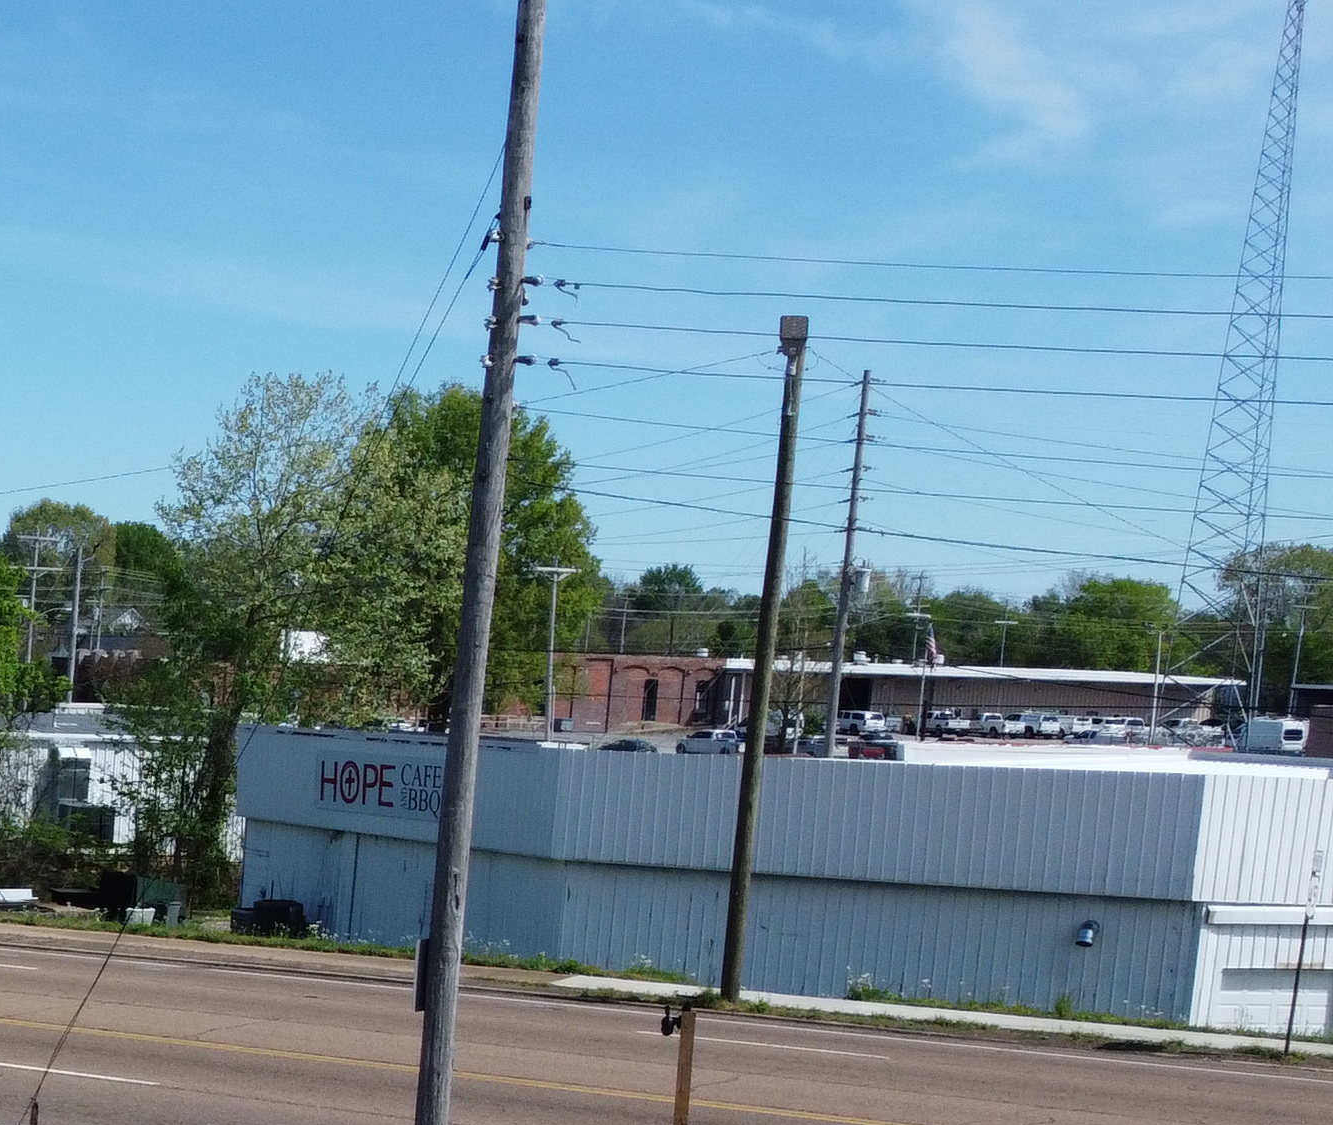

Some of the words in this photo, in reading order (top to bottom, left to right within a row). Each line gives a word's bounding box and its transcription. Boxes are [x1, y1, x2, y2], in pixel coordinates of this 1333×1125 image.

[320, 760, 396, 807] HOPE
[401, 763, 442, 788] CAFE
[408, 788, 440, 819] BBQ
